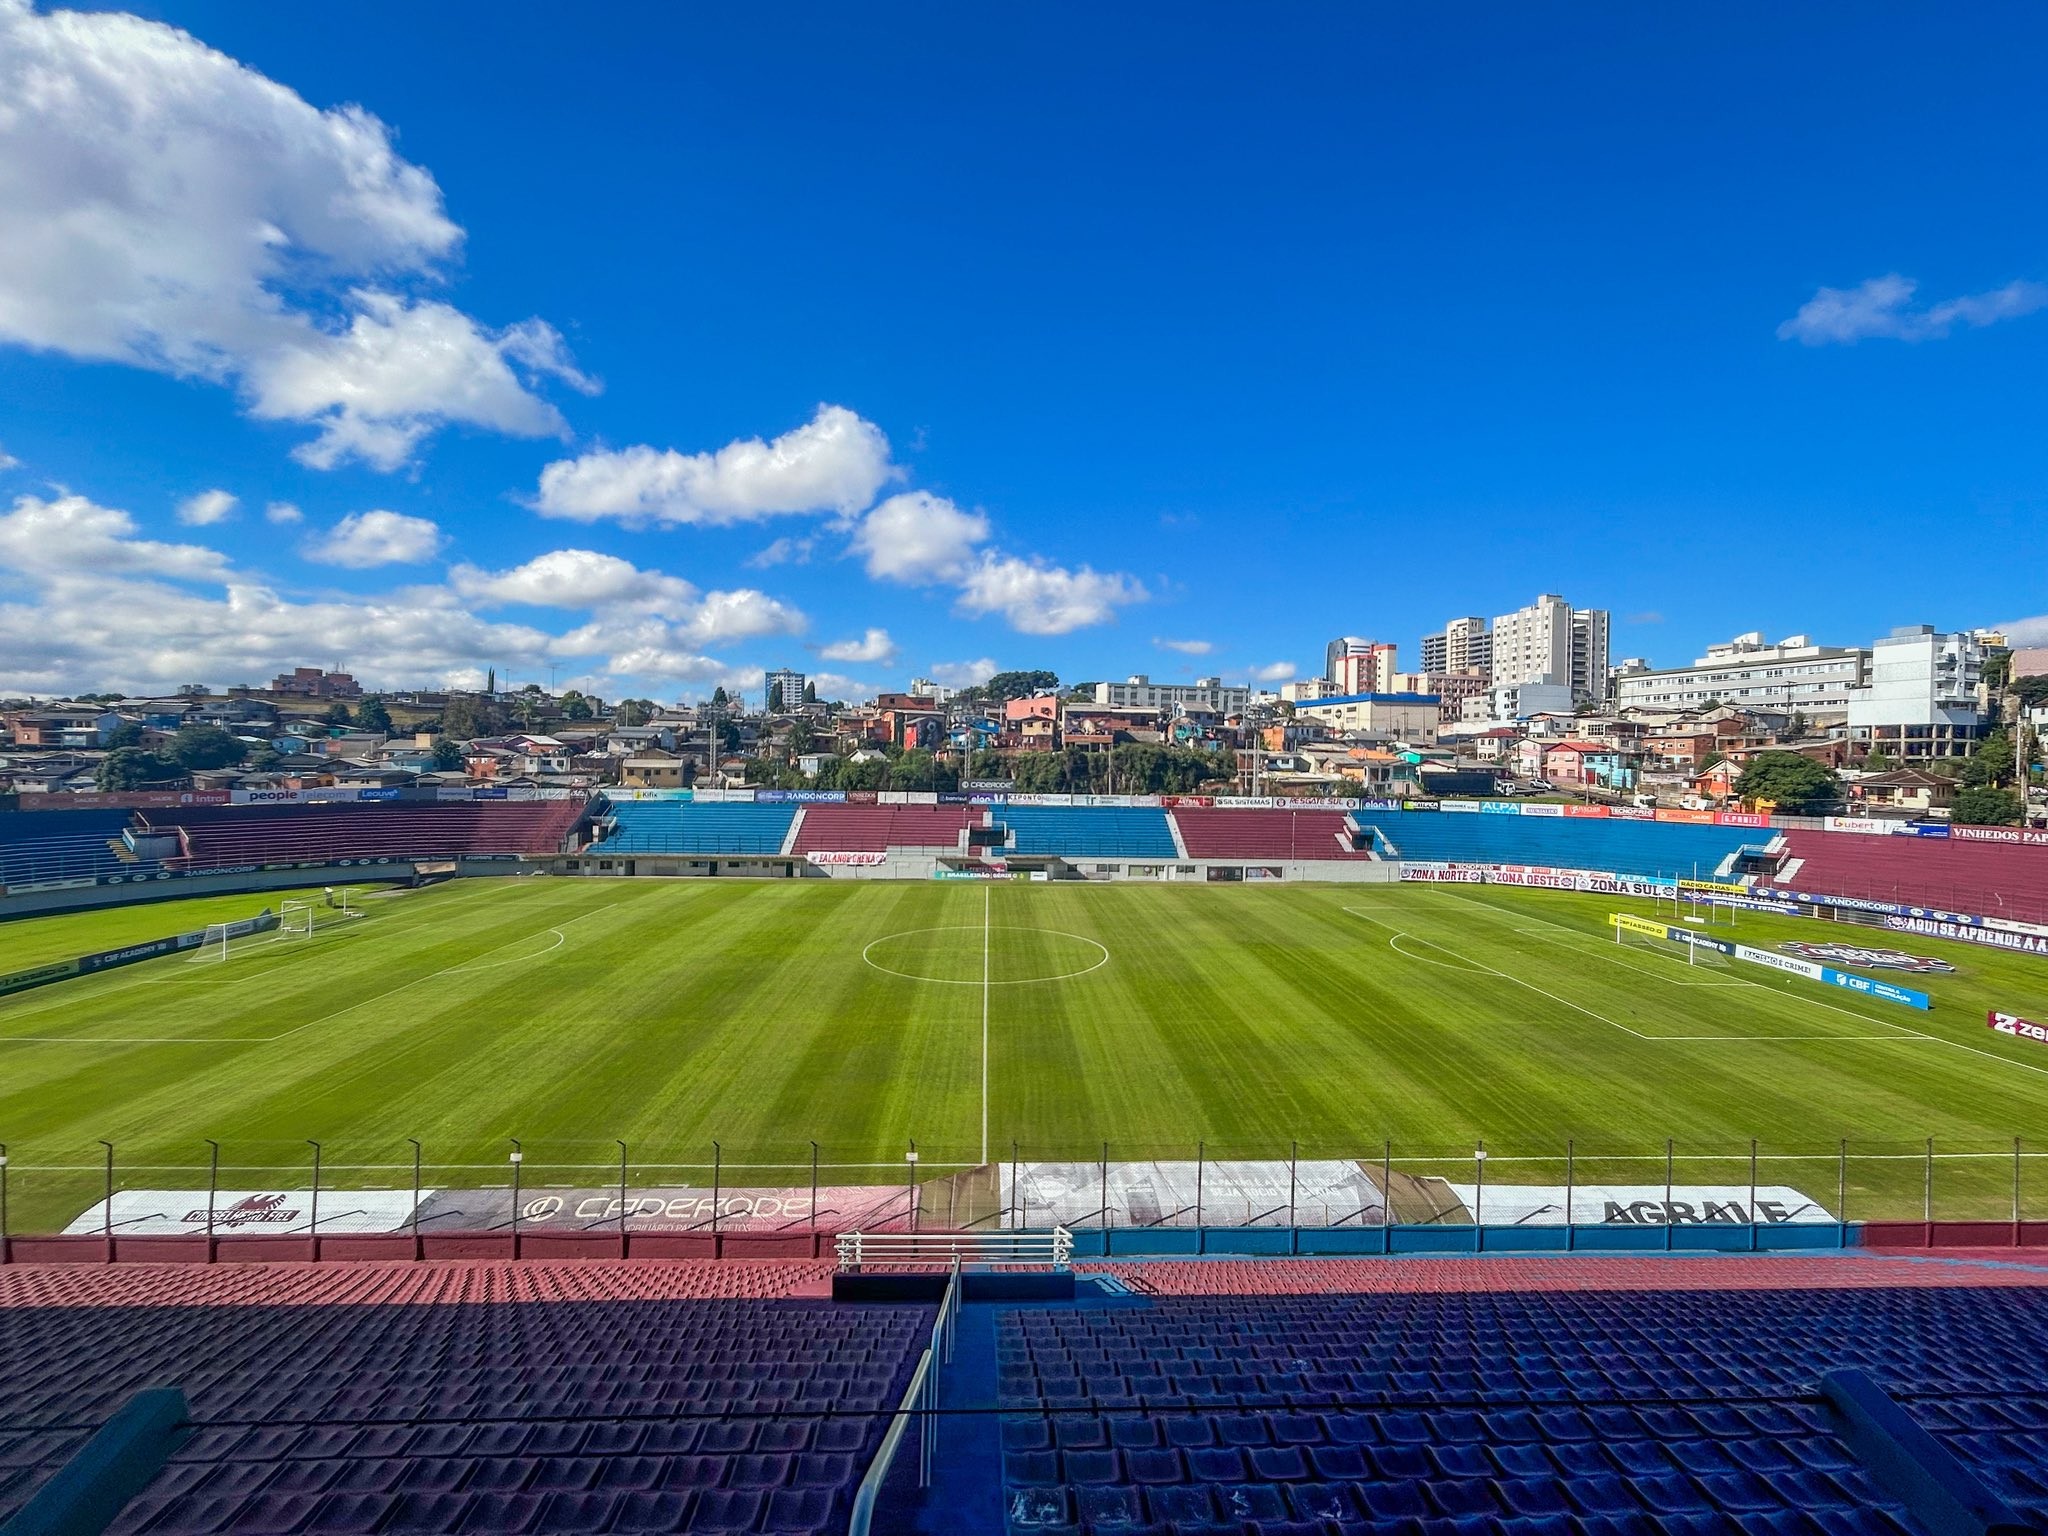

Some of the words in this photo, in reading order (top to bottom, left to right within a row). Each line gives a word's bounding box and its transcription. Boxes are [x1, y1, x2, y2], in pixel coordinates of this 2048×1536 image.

[249, 790, 298, 802] people
[301, 790, 347, 799] Telecom
[362, 790, 394, 798] Leouve
[642, 789, 658, 798] Kifix
[786, 792, 846, 800] RANDONCORP
[1289, 796, 1324, 805] RESGATE
[1326, 797, 1344, 806] SUL
[1482, 802, 1519, 811] ALPA
[1953, 827, 2020, 842] VINHEDOS
[184, 865, 257, 877] RANDONCORP
[1411, 869, 1435, 880] ZONA
[1438, 870, 1469, 881] NORTE
[1495, 872, 1525, 885] ZONA
[1527, 874, 1560, 887] OESTE
[1590, 879, 1630, 893] ZONA
[1633, 883, 1661, 895] SUL
[1703, 883, 1731, 892] CAXIAS
[1823, 896, 1897, 912] RANDONCORP
[1906, 917, 1938, 932] AQUI
[1939, 921, 1957, 937] SE
[1957, 926, 2022, 949] APRENDE
[2022, 937, 2035, 951] A
[1744, 950, 1780, 967] RACISMO
[1849, 978, 1871, 991] CBF
[574, 1196, 812, 1219] CADERODE
[187, 1210, 267, 1222] CONSELHEIRO
[265, 1210, 294, 1222] FIEL
